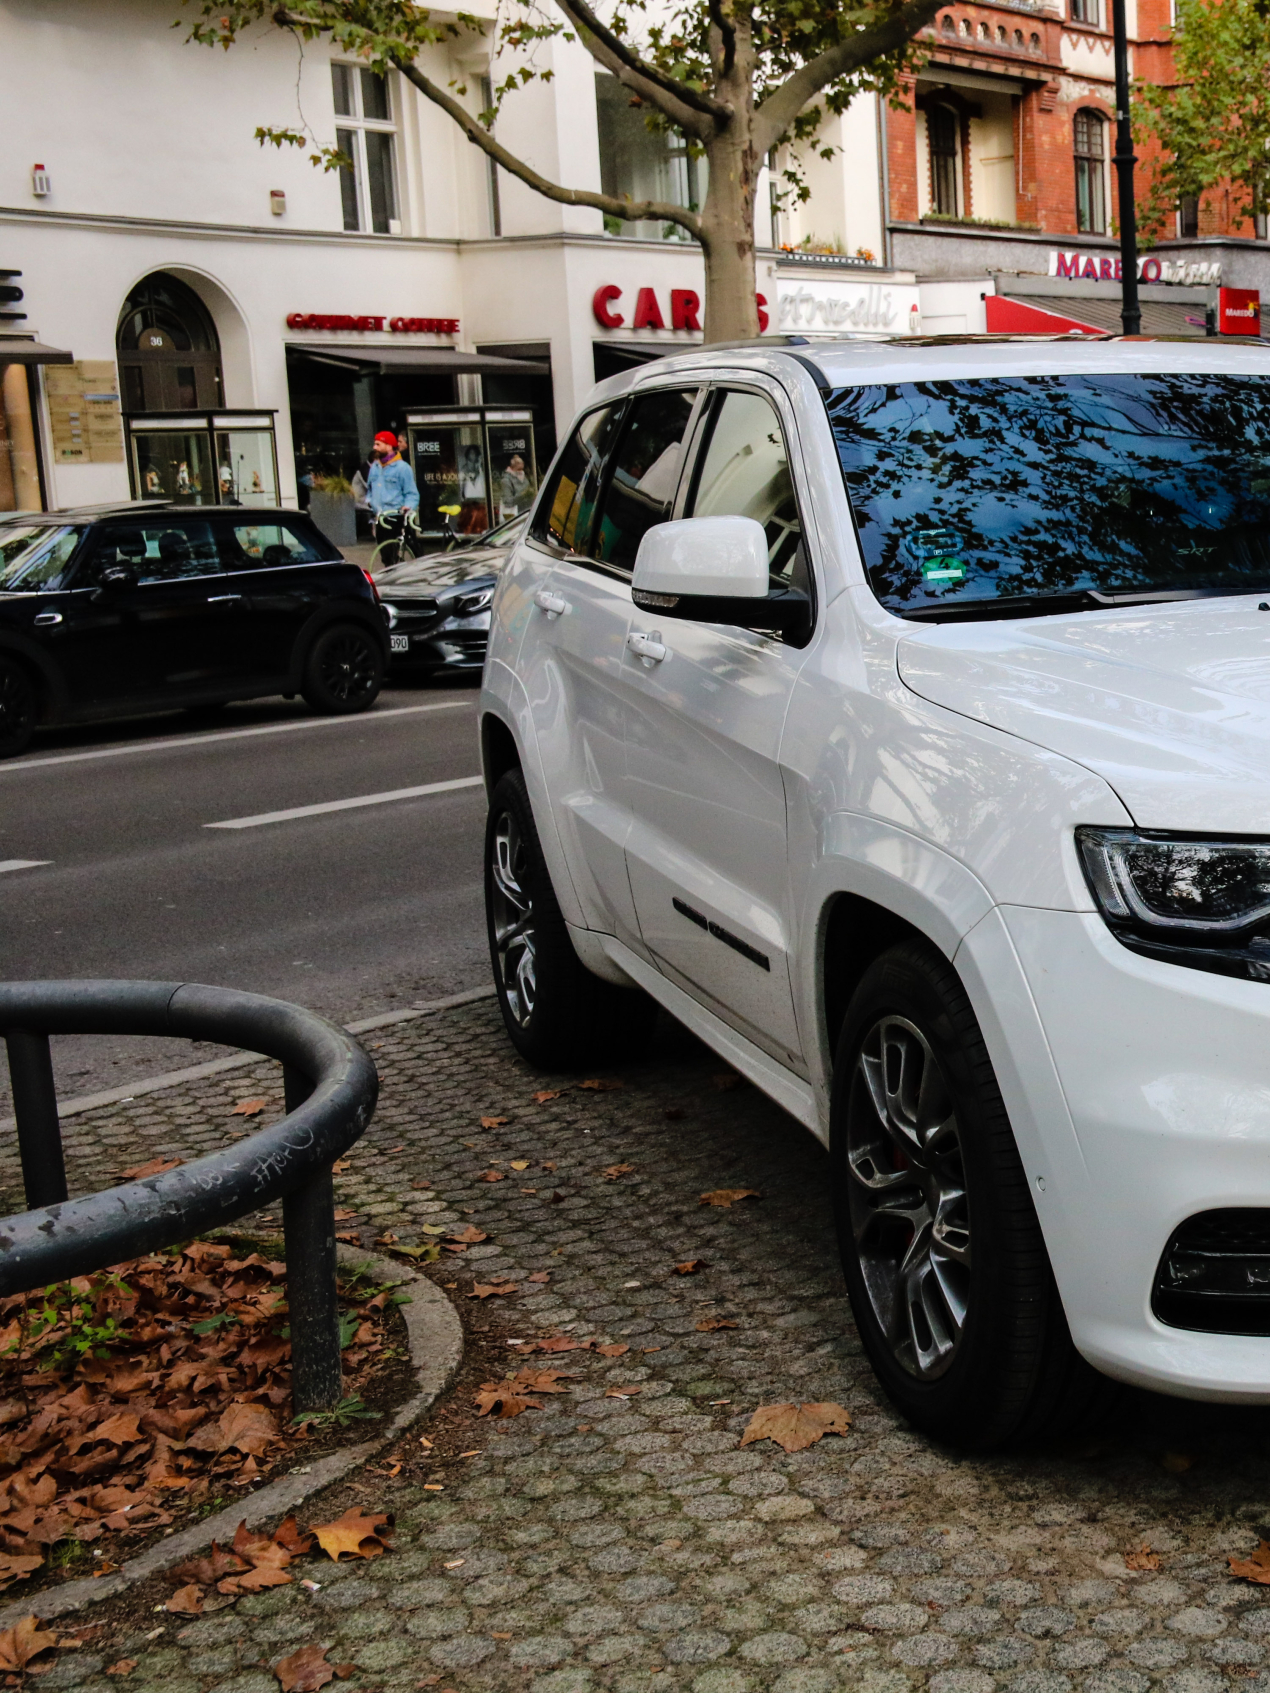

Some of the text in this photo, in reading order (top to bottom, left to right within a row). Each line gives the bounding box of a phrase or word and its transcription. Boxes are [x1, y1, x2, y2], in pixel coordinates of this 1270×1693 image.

[1056, 252, 1162, 282] MAREO
[593, 284, 769, 333] CARS
[1225, 308, 1255, 318] MAREDO
[417, 441, 440, 452] BREE
